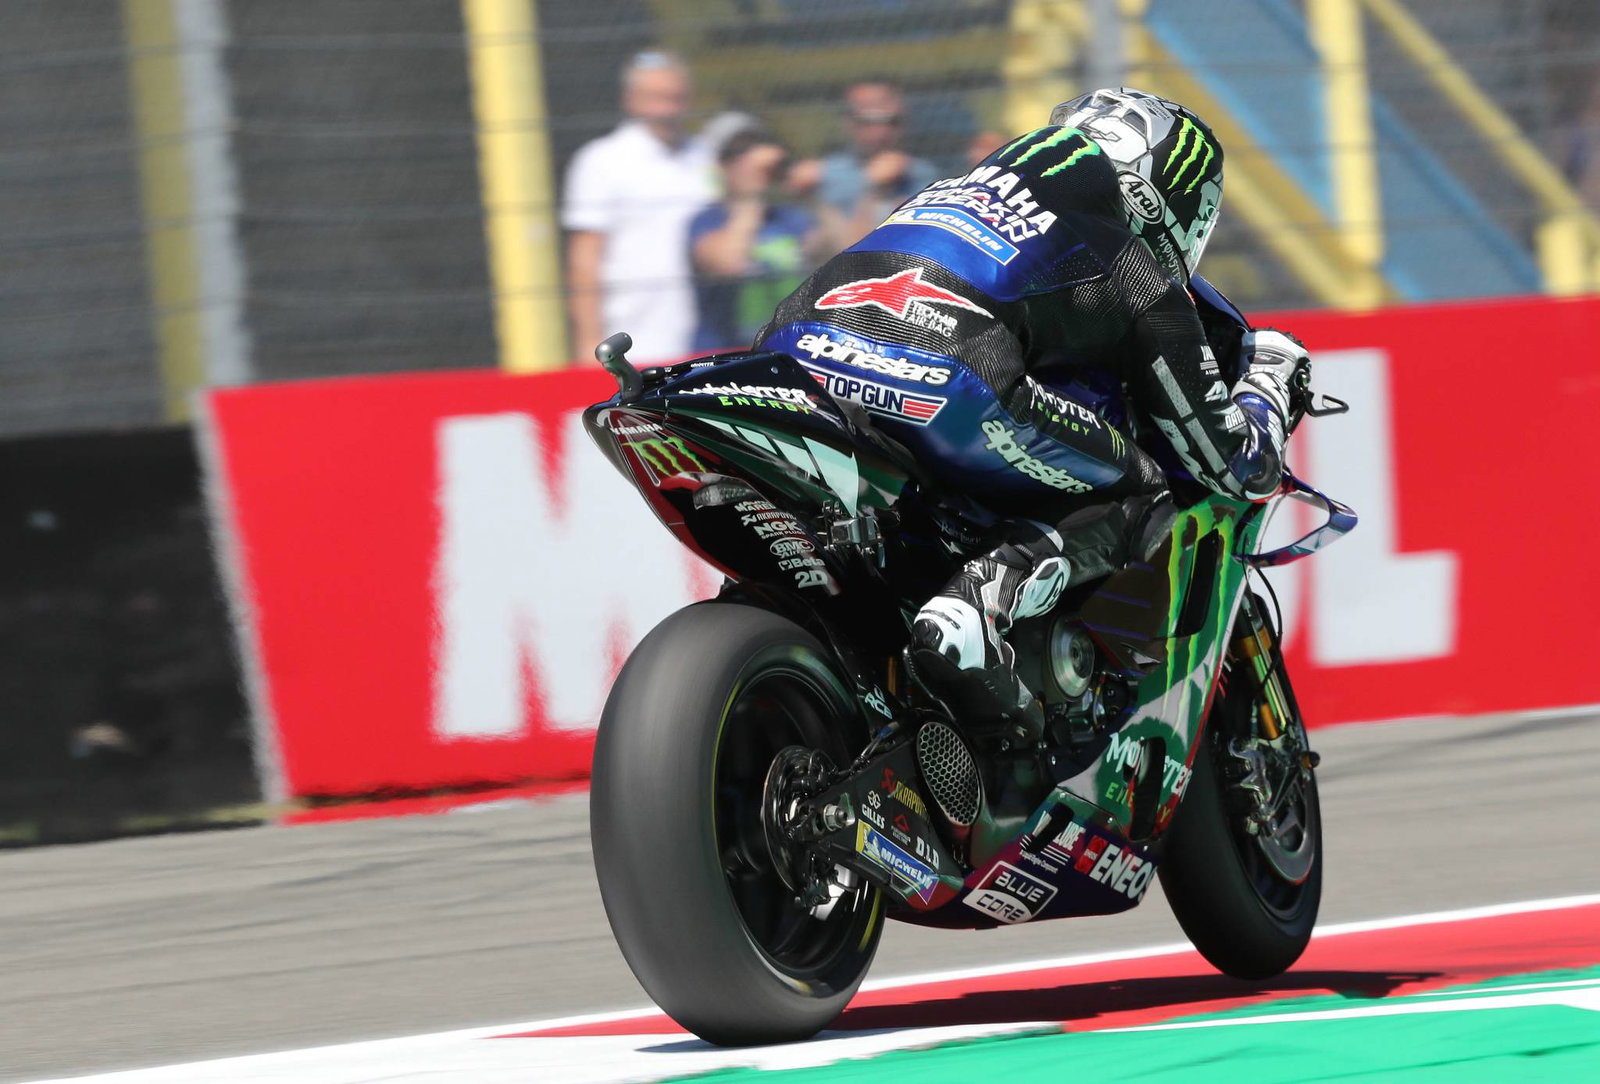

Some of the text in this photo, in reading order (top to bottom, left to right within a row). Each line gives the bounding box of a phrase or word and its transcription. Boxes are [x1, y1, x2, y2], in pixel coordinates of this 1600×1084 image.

[924, 165, 1058, 235] YAMAHA
[1123, 180, 1161, 216] Arai
[915, 211, 1004, 251] MICHELIN
[1156, 231, 1182, 282] MONSTE
[796, 332, 952, 387] alpinestars
[717, 395, 810, 415] ENERGY
[824, 374, 904, 411] TOP GUN
[609, 422, 665, 436] YAMAHA
[981, 419, 1093, 495] alpinestars
[753, 520, 803, 537] NGK
[773, 540, 812, 555] BMC
[790, 557, 826, 568] Beta
[794, 569, 829, 589] 2D
[861, 803, 886, 830] GILLES
[880, 847, 933, 890] MICHELIN
[915, 835, 940, 871] D.I.D
[994, 870, 1045, 903] BLUE
[976, 893, 1026, 921] CORE
